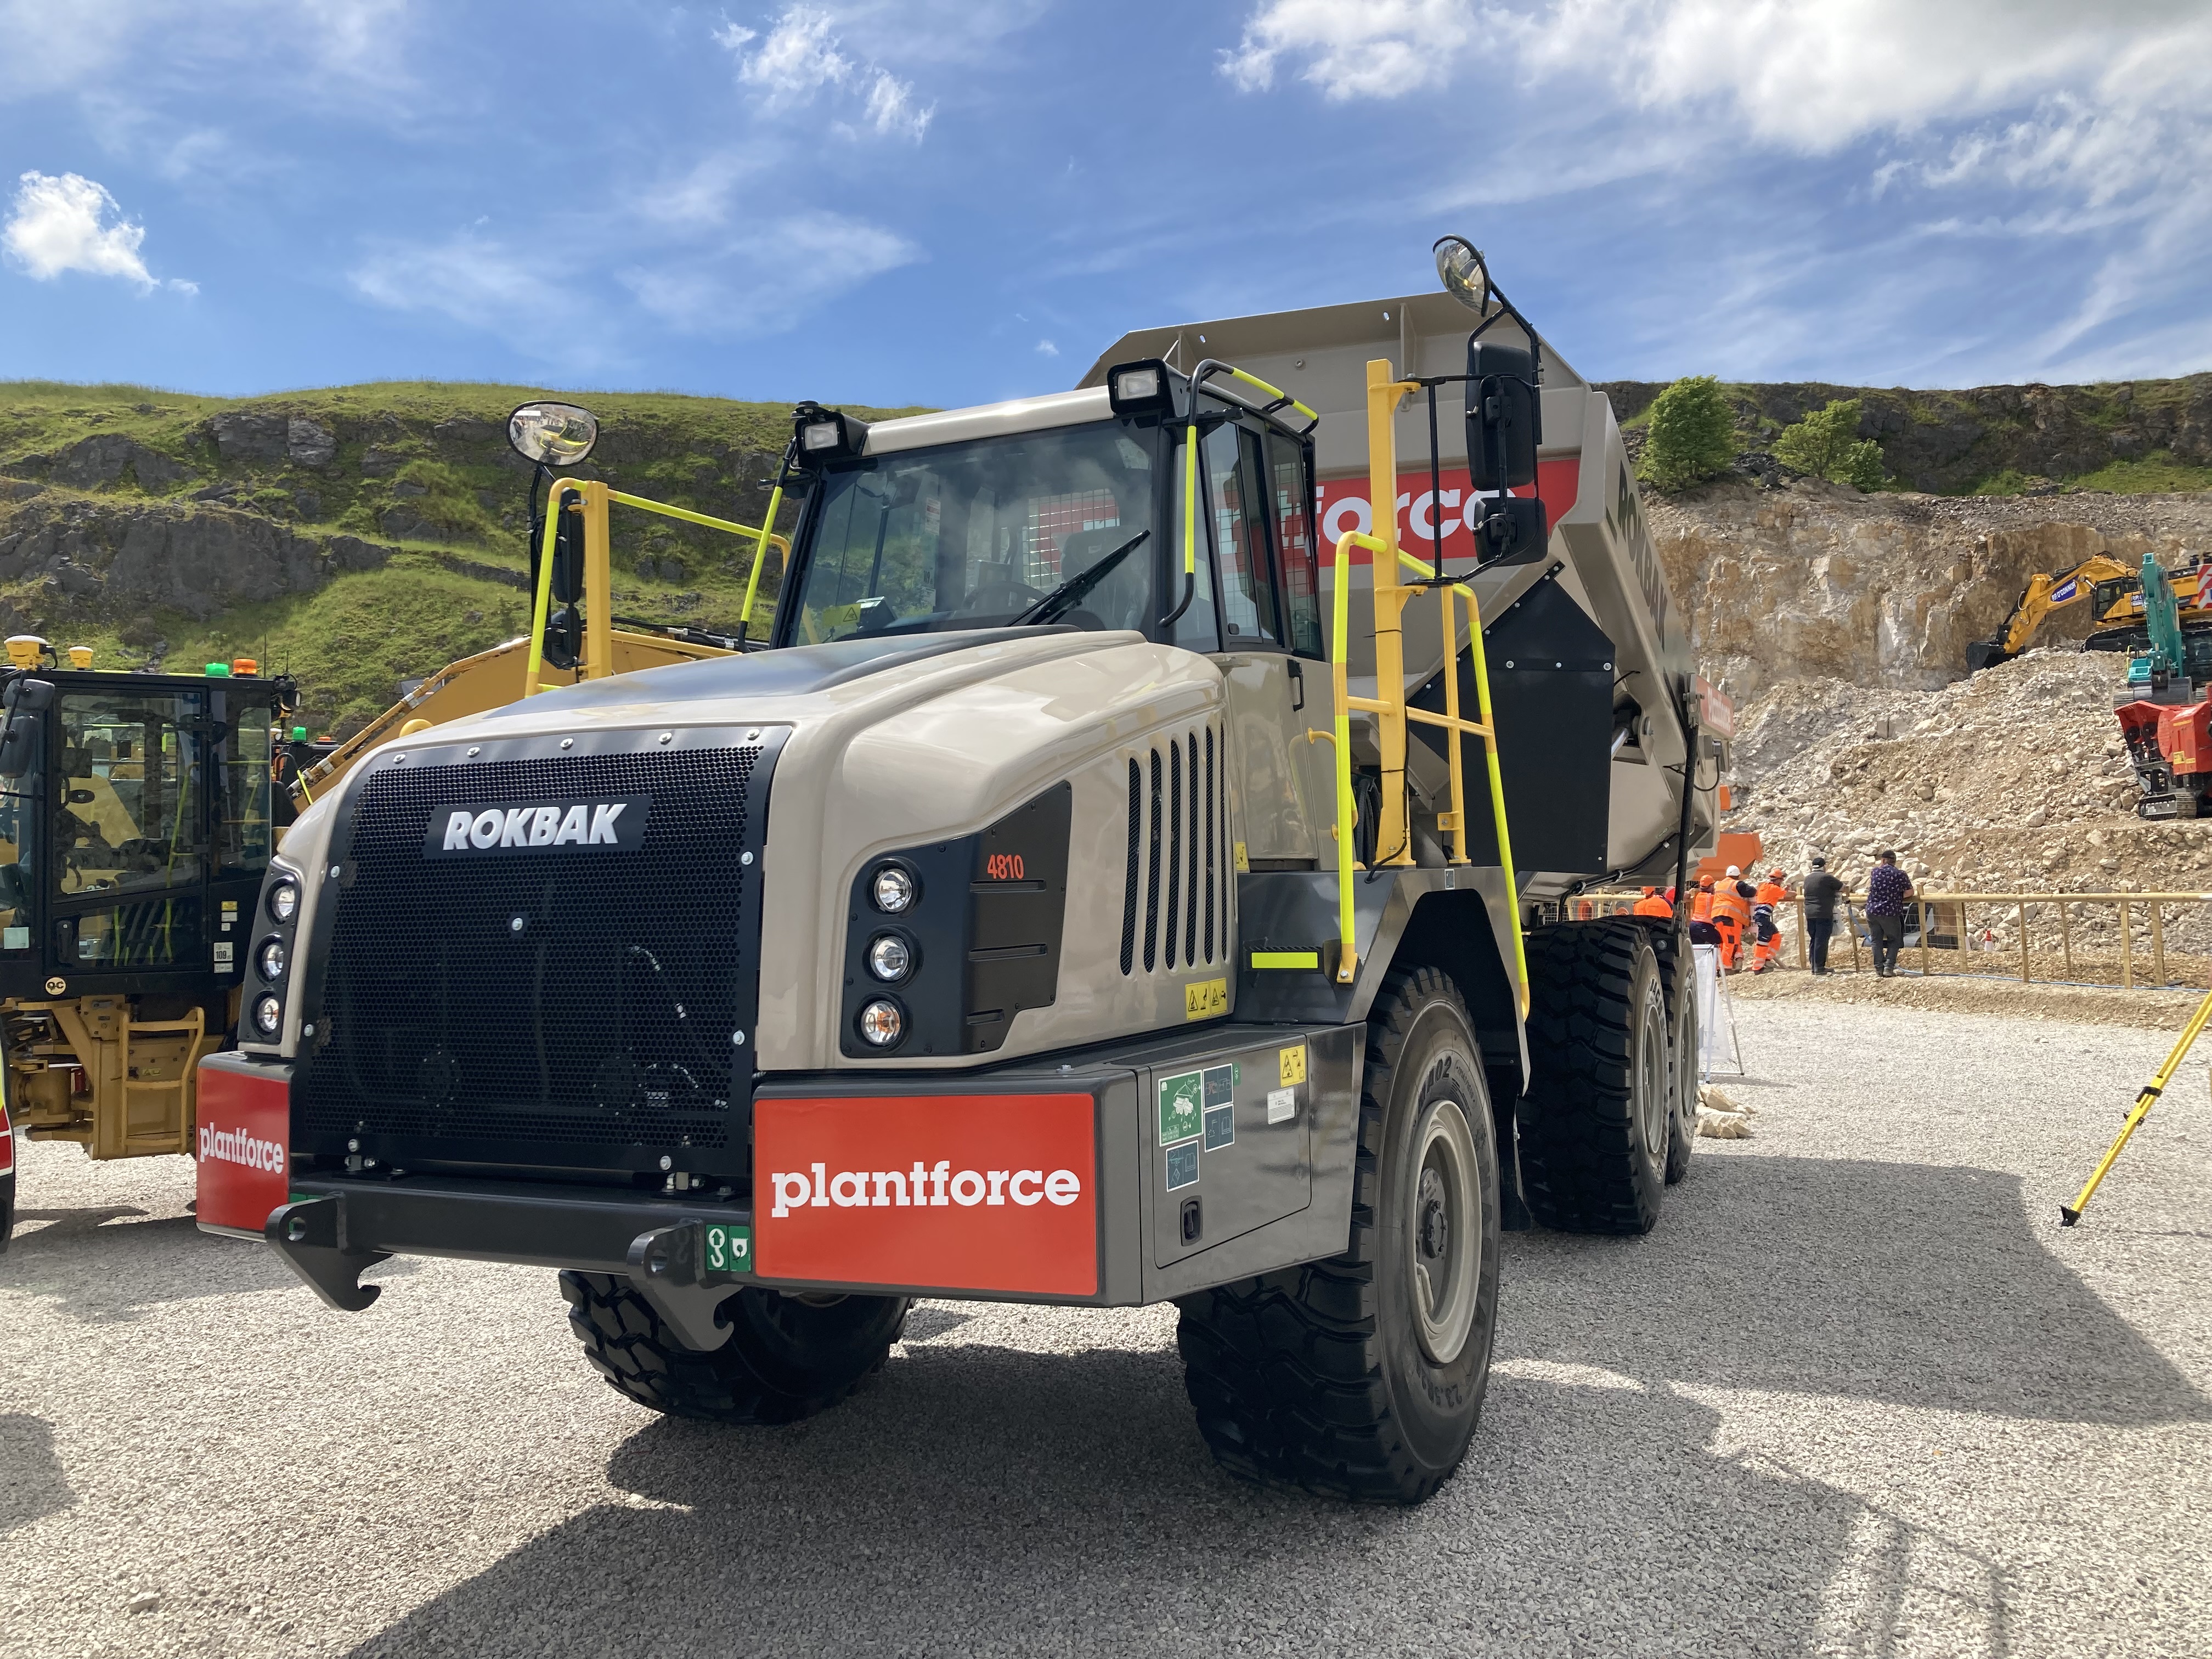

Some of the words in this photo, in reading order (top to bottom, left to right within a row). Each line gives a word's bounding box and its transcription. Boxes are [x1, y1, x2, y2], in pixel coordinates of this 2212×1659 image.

[1618, 459, 1667, 653] ROKBAK
[443, 803, 627, 850] ROKBAK
[988, 854, 1024, 879] 4810
[216, 950, 227, 960] 109
[200, 1122, 284, 1174] plantforce
[771, 1160, 1081, 1217] plantforce
